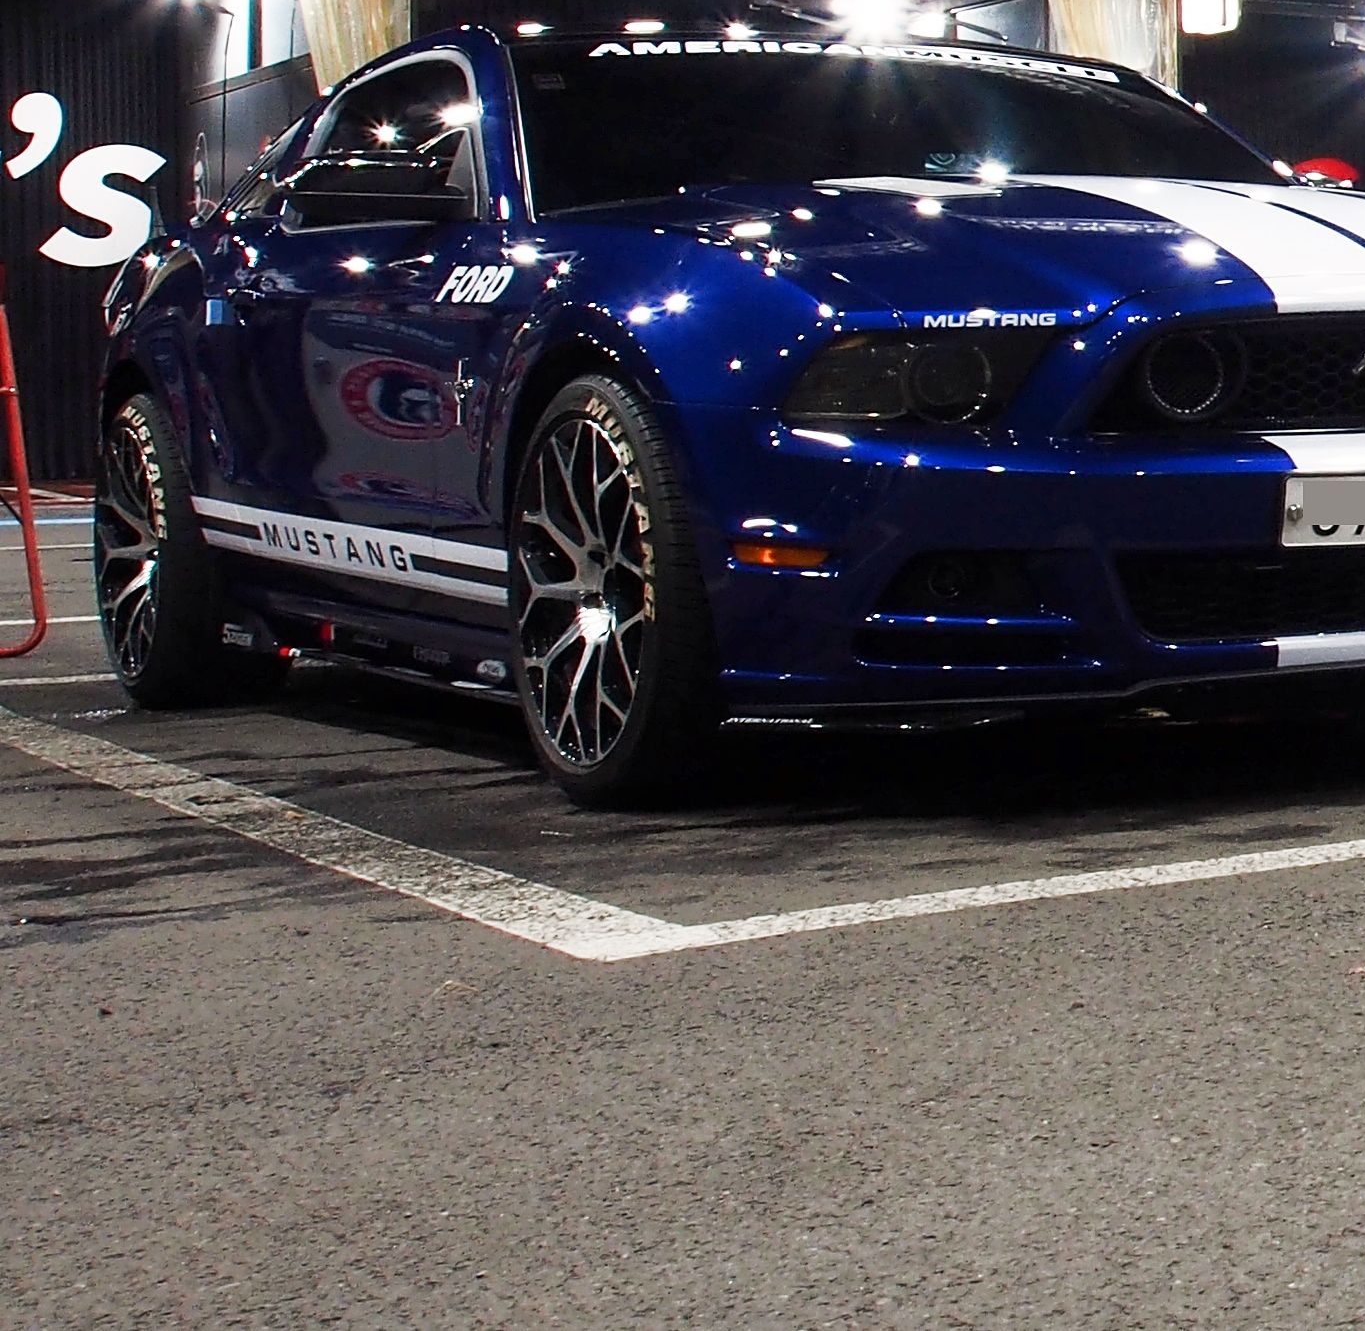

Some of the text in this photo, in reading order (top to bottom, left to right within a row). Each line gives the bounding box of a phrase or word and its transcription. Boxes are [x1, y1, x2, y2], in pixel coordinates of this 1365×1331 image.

[434, 265, 515, 304] FORD
[923, 312, 1057, 329] MUSTANG
[259, 520, 411, 572] MUSTANG
